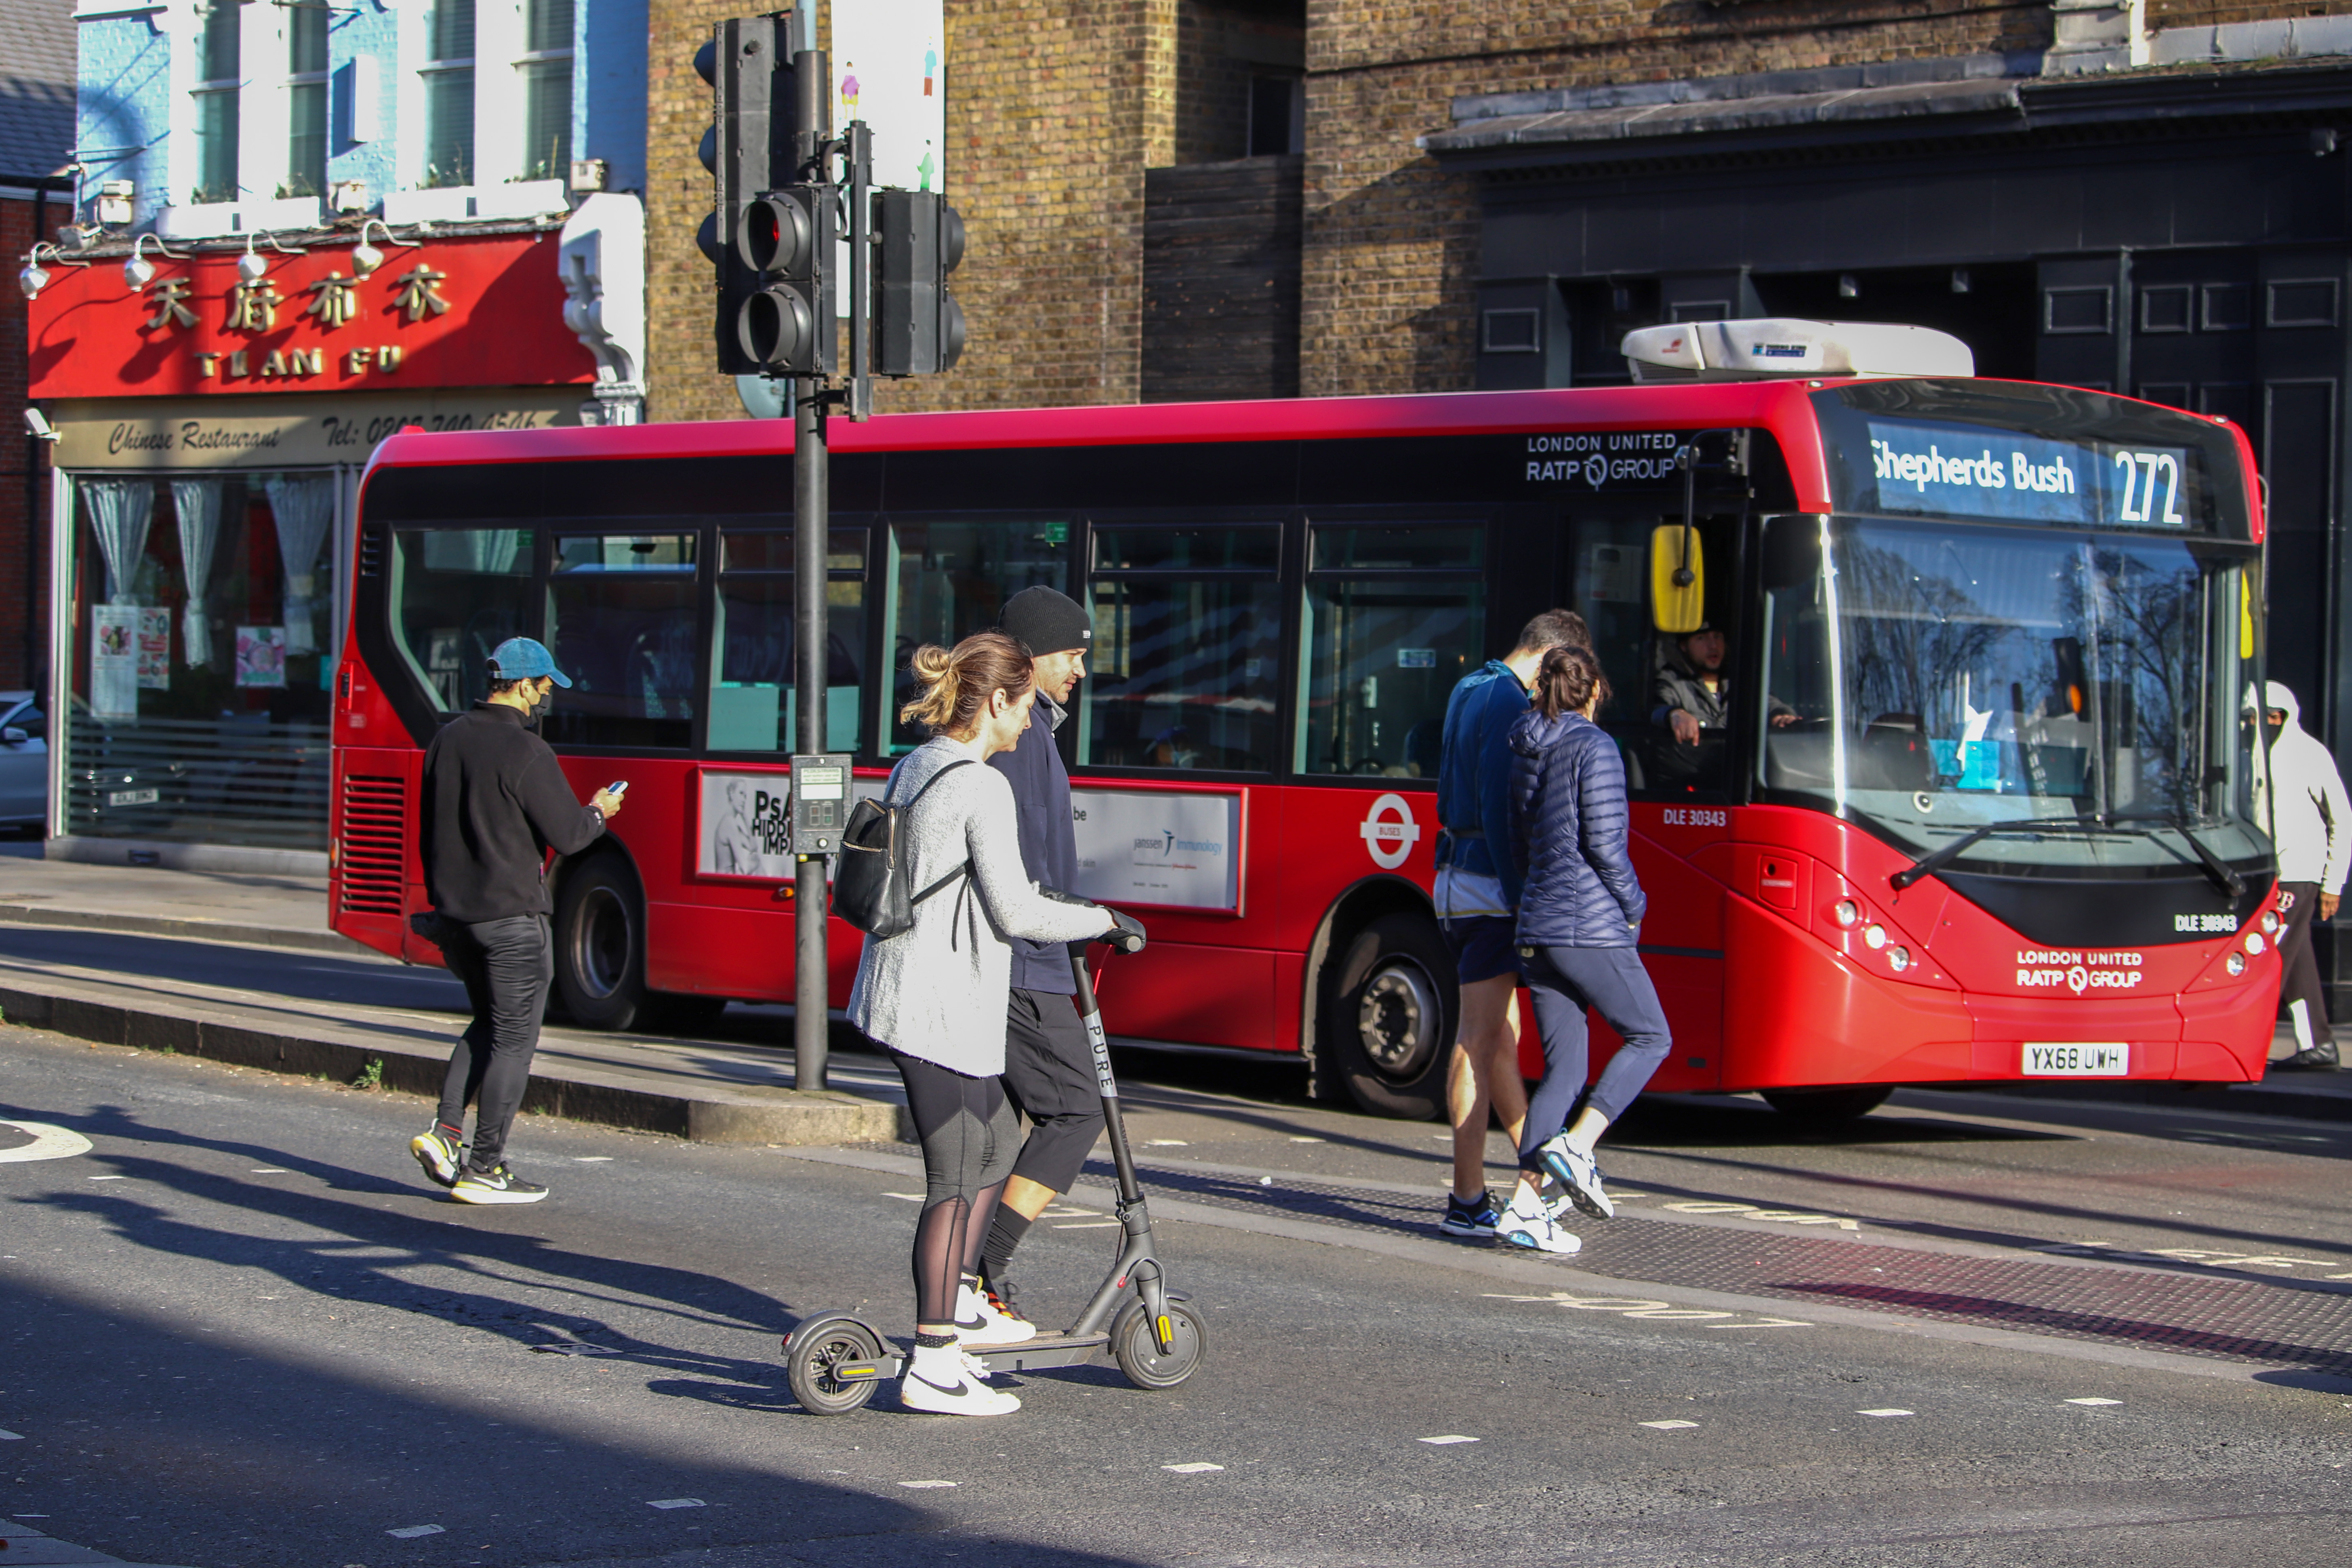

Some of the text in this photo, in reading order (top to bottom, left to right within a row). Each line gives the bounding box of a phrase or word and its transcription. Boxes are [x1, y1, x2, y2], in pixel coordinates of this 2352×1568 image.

[195, 345, 402, 377] TIAN FU
[109, 423, 173, 454] Chinese
[182, 422, 281, 450] Restaurant
[322, 417, 358, 447] Tel:
[1528, 434, 1676, 453] LONDON UNITED
[1526, 458, 1675, 481] RATP GROUP
[1870, 439, 2182, 524] Shepherds Bush 272
[1073, 806, 1087, 821] be
[1664, 809, 1726, 827] DLE 30343
[1379, 827, 1401, 836] BUSES
[2175, 914, 2199, 932] DLE
[2017, 951, 2142, 966] LONDON UNITED
[2017, 970, 2142, 987] RATP GROUP
[1089, 1025, 1113, 1088] PURE
[2032, 1048, 2118, 1069] YX68 UWH
